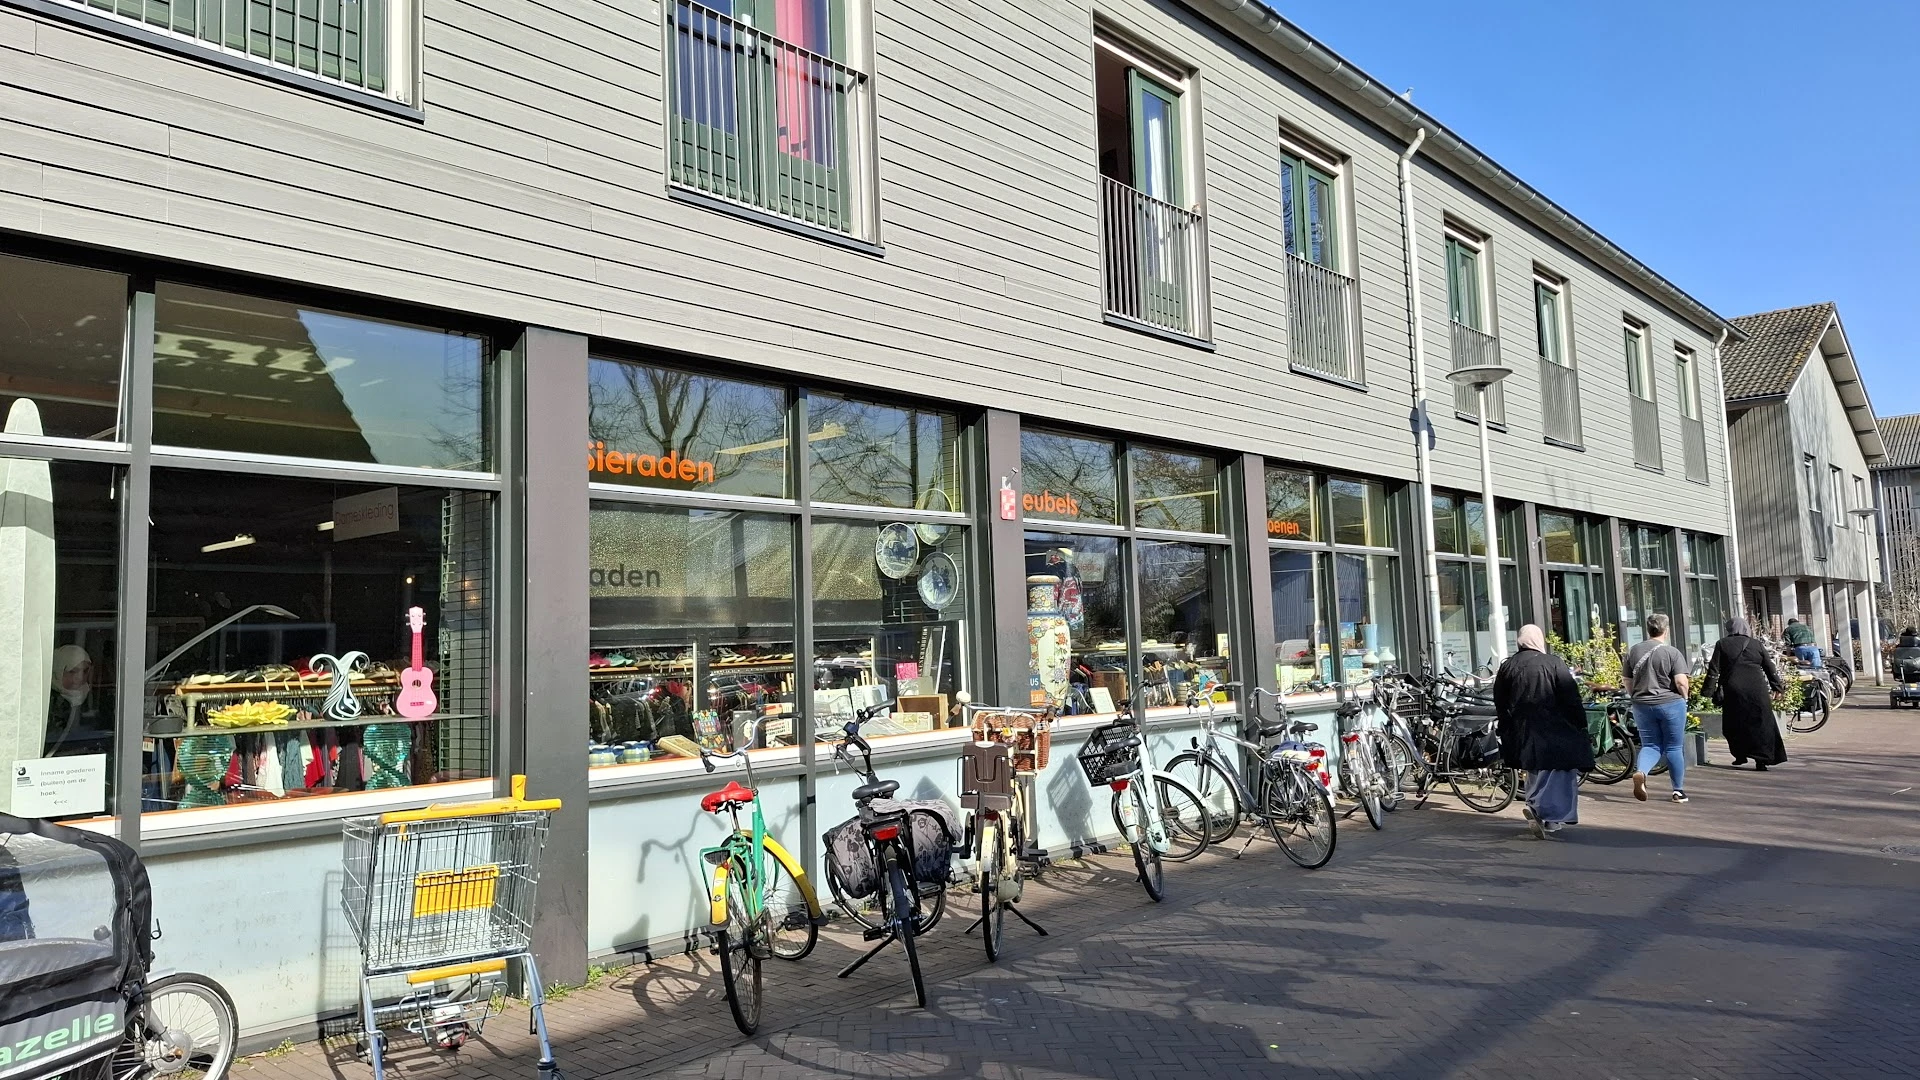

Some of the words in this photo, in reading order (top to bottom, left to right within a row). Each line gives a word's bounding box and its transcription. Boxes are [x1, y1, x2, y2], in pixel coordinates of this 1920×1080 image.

[1022, 490, 1079, 515] eubels
[1267, 520, 1299, 534] oenen
[589, 563, 661, 588] aden
